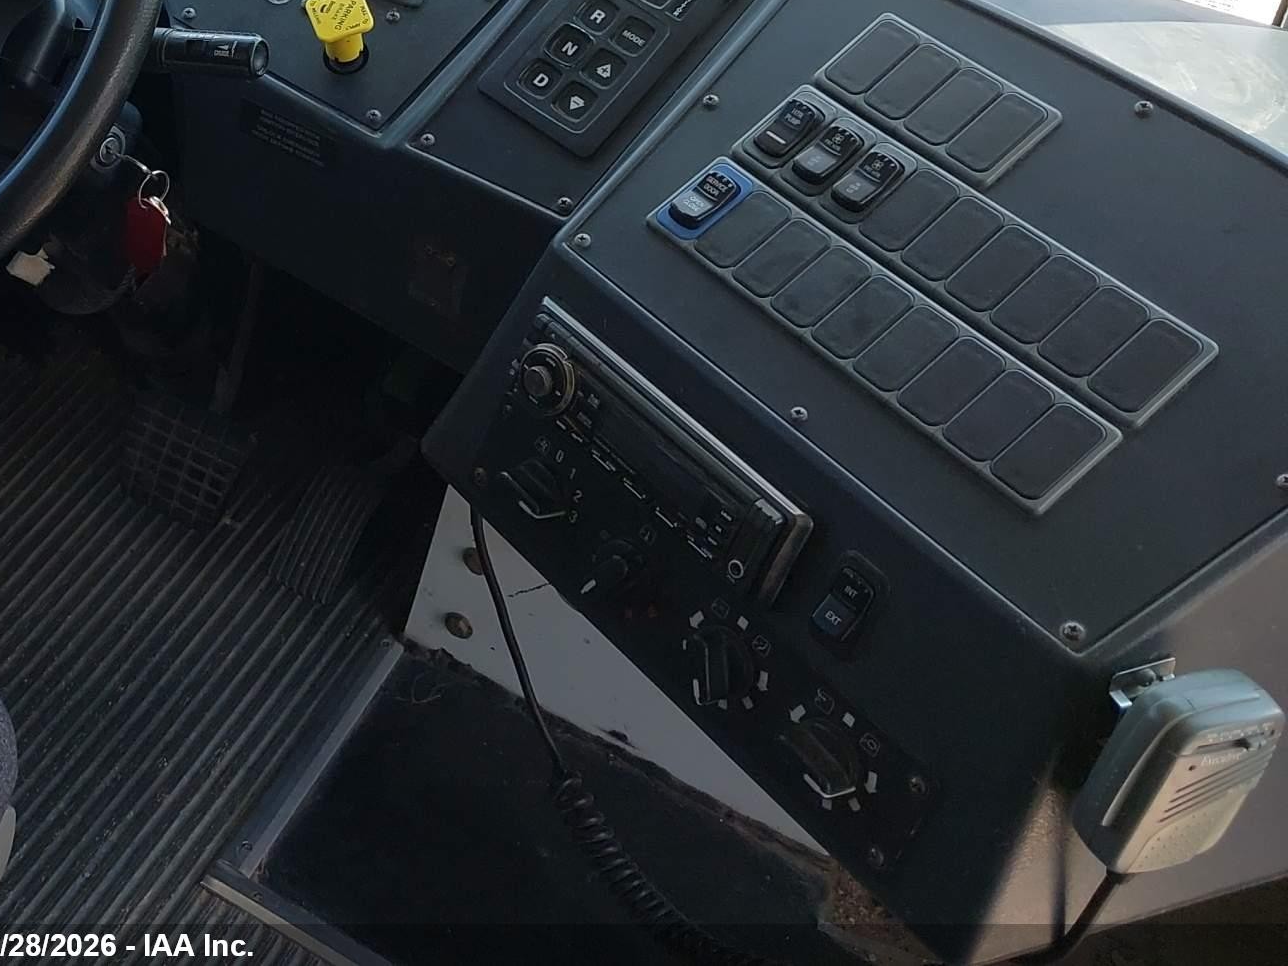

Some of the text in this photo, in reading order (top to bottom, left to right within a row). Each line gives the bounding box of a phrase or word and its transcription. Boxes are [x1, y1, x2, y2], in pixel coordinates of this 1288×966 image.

[334, 0, 357, 31] PARKING
[589, 9, 606, 24] R
[622, 30, 645, 47] MODE
[561, 41, 578, 56] N
[533, 73, 549, 87] D
[703, 183, 720, 196] DOOR
[706, 176, 728, 193] SERVICE
[555, 449, 564, 463] 0
[573, 490, 583, 503] 2
[569, 510, 578, 523] 3
[844, 585, 858, 599] INT
[825, 610, 842, 626] EXT
